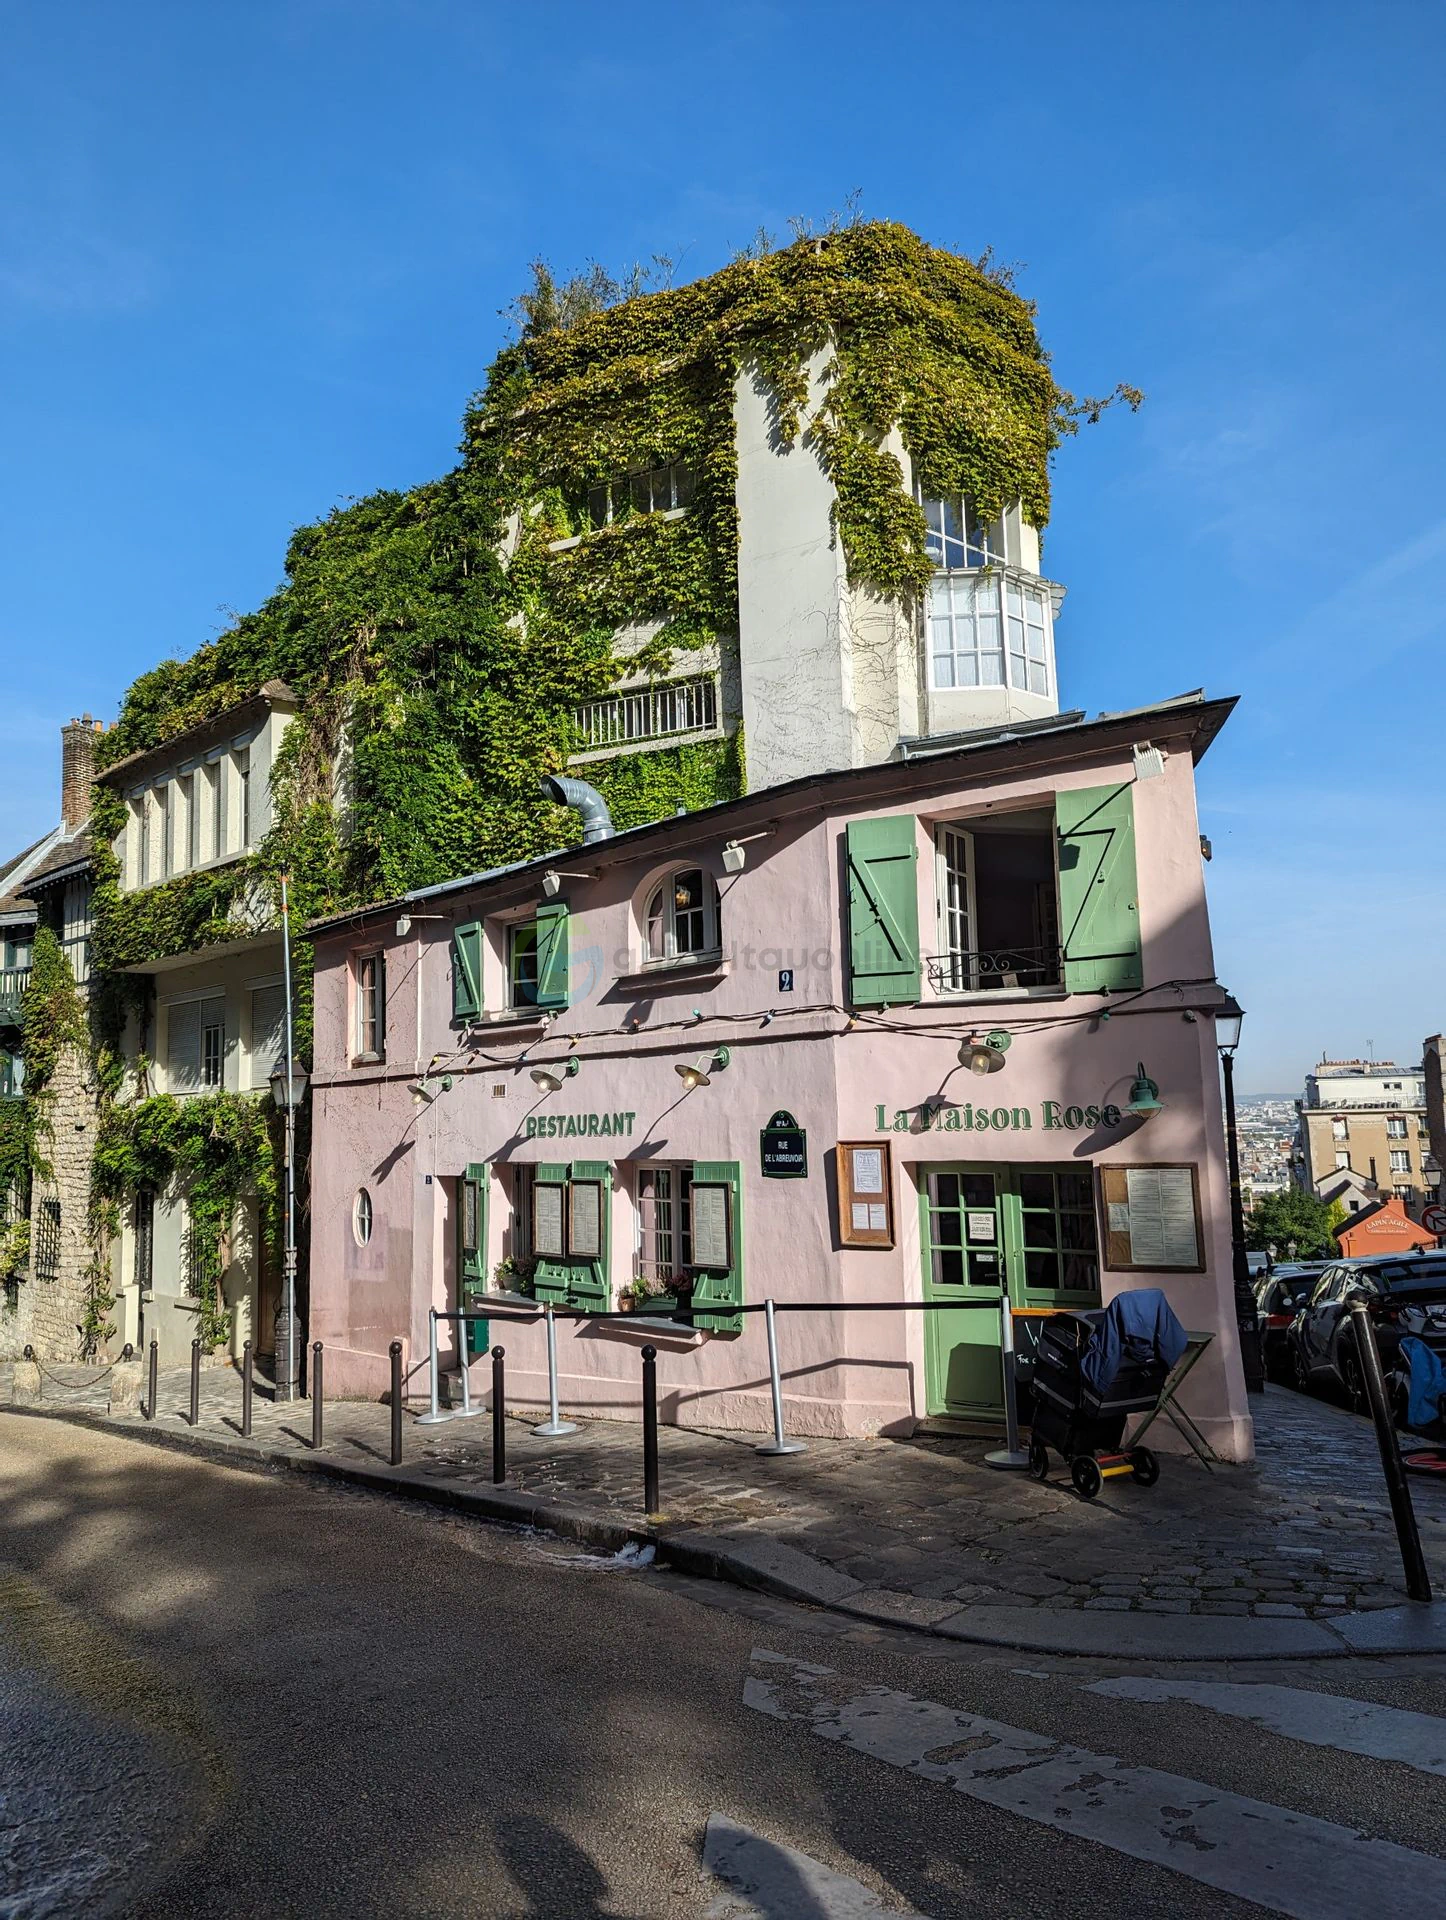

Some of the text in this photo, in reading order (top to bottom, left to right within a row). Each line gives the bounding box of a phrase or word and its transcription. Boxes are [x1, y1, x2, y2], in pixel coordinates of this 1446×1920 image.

[874, 1100, 1121, 1132] La Maison Rose
[526, 1112, 636, 1139] RESTAURANT
[777, 1141, 788, 1149] RUE
[765, 1154, 804, 1162] DE L'ABREUVOIR
[1367, 1219, 1408, 1229] LAPIN AGILE
